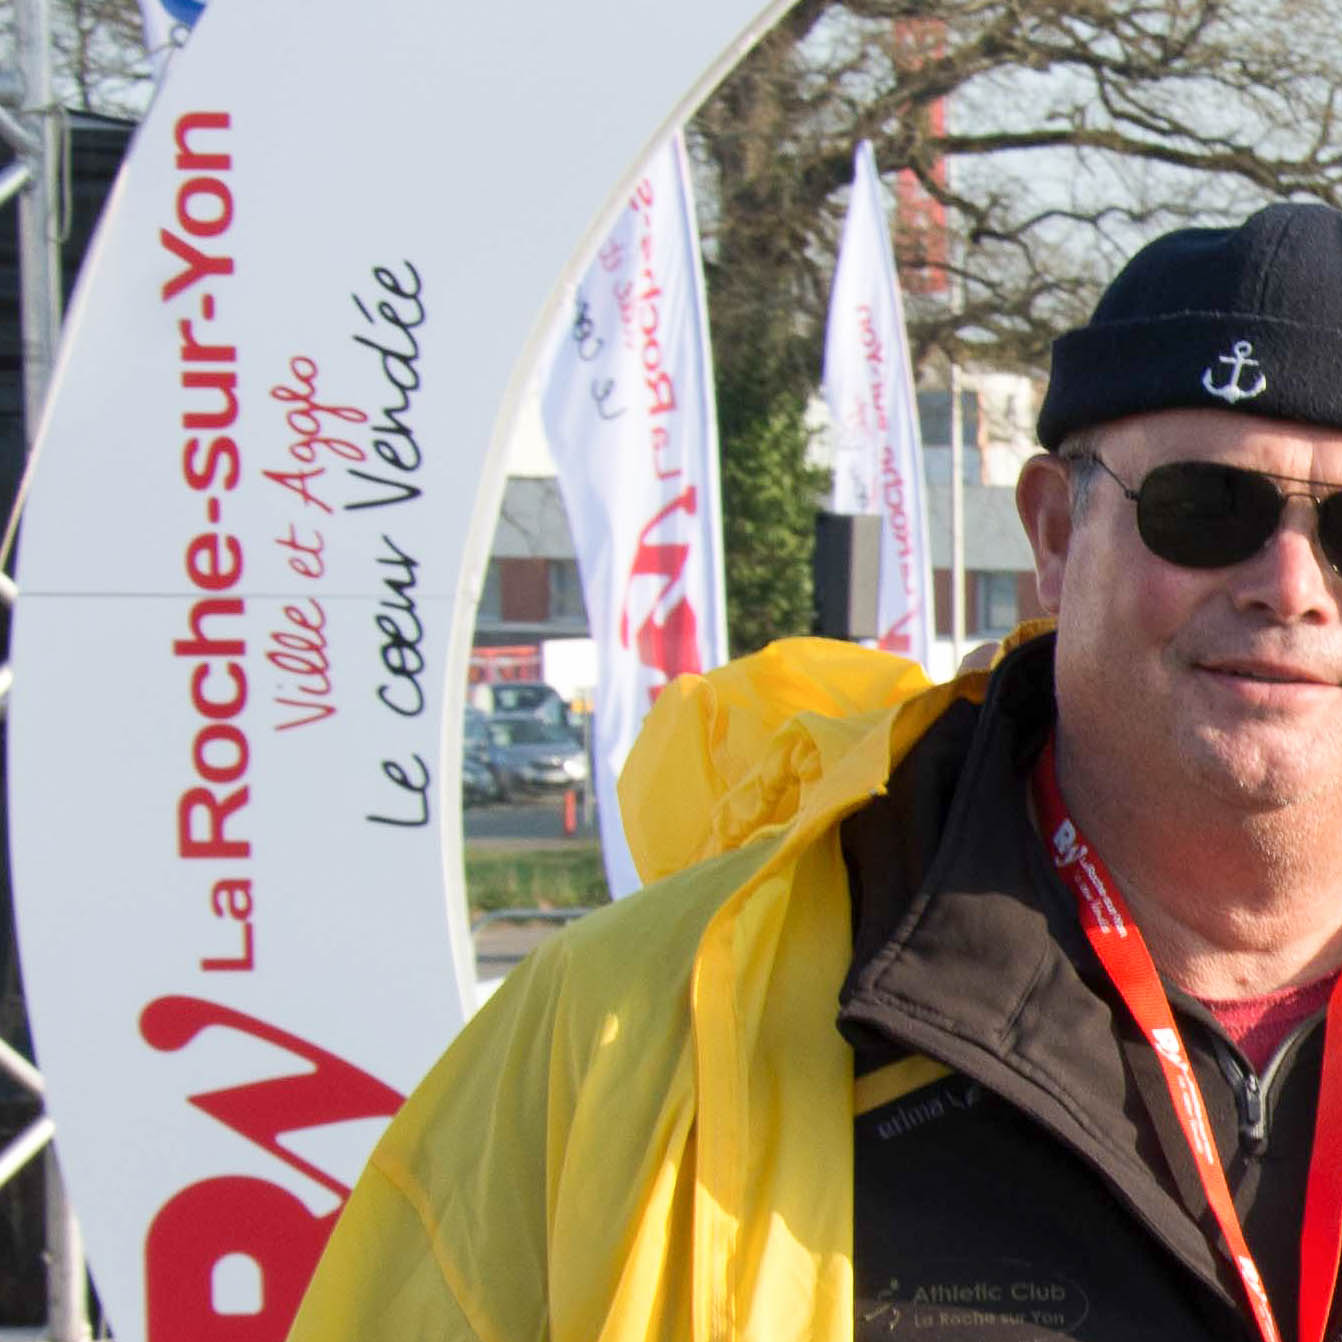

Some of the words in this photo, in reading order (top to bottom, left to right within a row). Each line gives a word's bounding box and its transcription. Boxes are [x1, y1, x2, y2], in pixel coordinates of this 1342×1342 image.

[261, 354, 368, 516] Agglo
[343, 259, 428, 513] Vendée
[160, 110, 251, 860] Roche-sur-Yon
[273, 525, 329, 585] et
[265, 596, 338, 733] Ville
[365, 754, 431, 830] Le
[200, 878, 256, 972] La
[913, 1282, 1002, 1304] Athletic
[1010, 1281, 1066, 1303] Club
